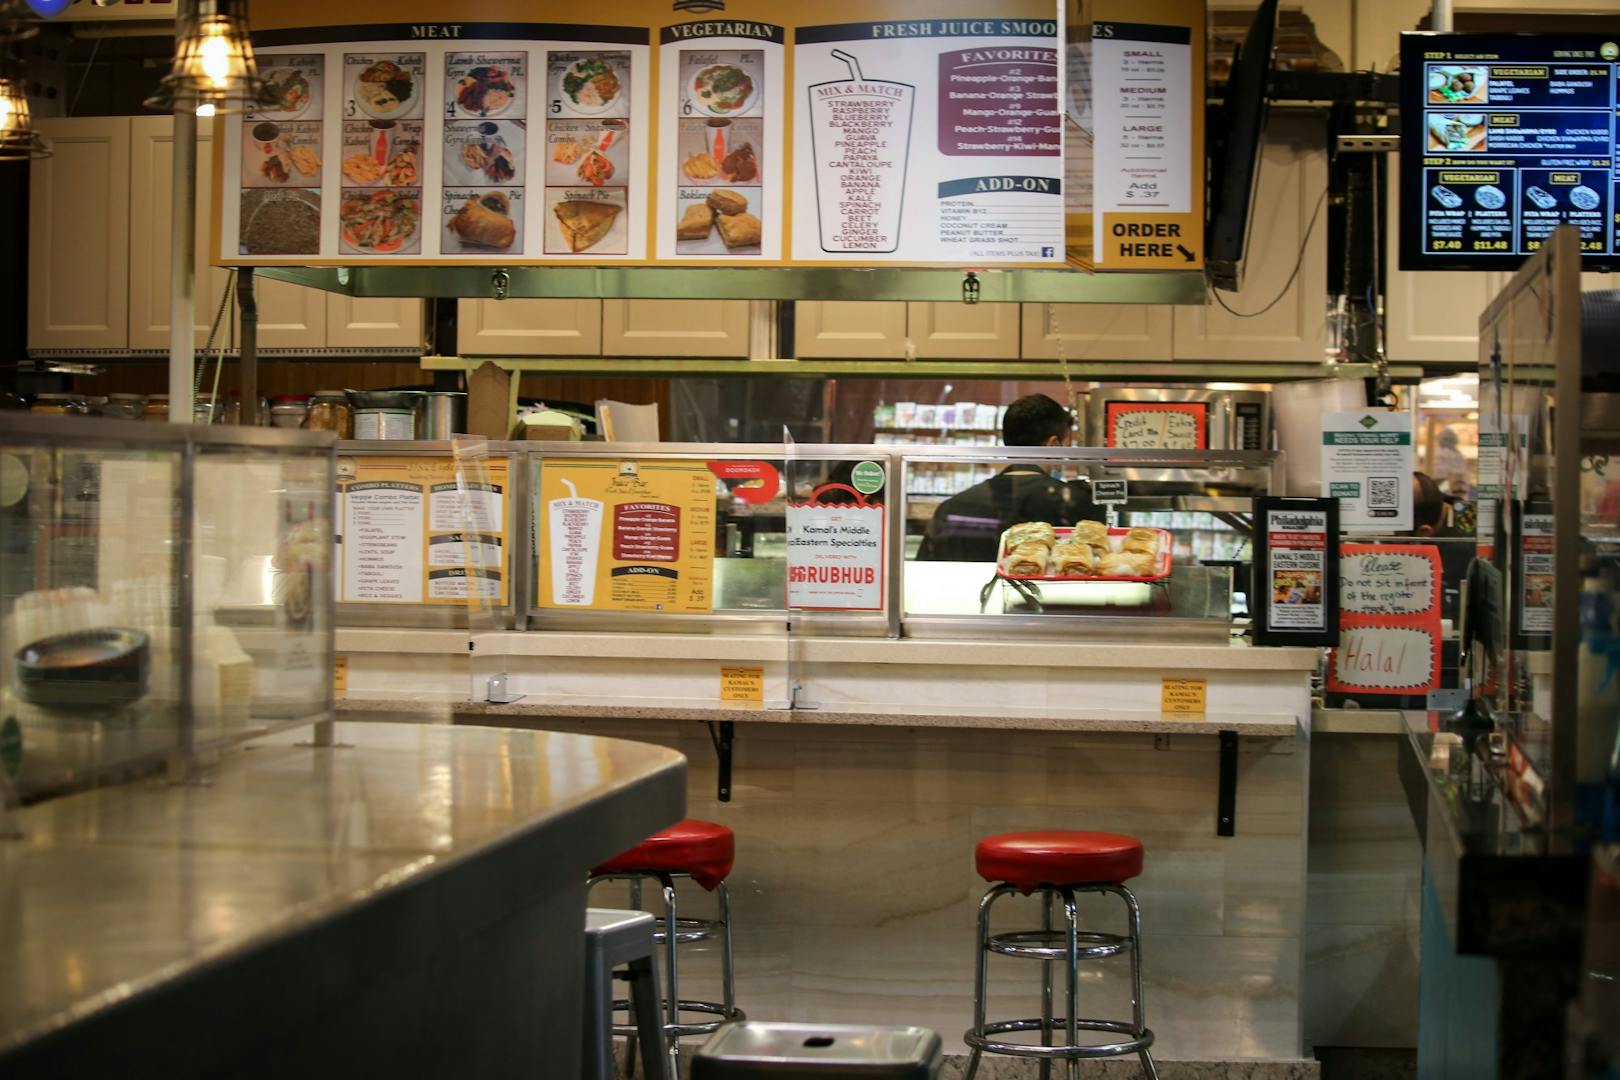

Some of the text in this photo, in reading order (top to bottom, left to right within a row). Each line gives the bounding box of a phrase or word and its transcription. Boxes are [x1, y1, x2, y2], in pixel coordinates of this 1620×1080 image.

[412, 25, 462, 38] MEAT
[671, 22, 774, 38] VEGETARIAN
[872, 22, 931, 38] FRESH
[939, 21, 993, 35] JUICE
[448, 55, 474, 65] Lamb
[951, 75, 1058, 83] Pineapple-Orange-Ban
[818, 85, 904, 98] MIX & MATCH
[447, 101, 456, 117] 4
[552, 100, 562, 114] 5
[683, 99, 692, 115] 6
[962, 109, 1060, 117] Mango-Orange-Gua
[955, 125, 1061, 134] Peach-Strawberry-Gu
[957, 142, 1061, 151] Strawberry-Kiwi-Man
[976, 178, 1050, 191] ADD-ON
[1112, 223, 1181, 237] ORDER
[1120, 243, 1173, 257] HERE
[624, 504, 671, 512] FAVORITES
[1271, 515, 1323, 527] Philadelphia
[803, 526, 870, 535] Kamal's Middle
[795, 538, 877, 548] Eastern Specialties
[1360, 555, 1403, 572] Please
[798, 566, 875, 585] GRUBHUB
[1357, 579, 1371, 587] not
[1376, 579, 1392, 587] sit
[1361, 590, 1376, 600] the
[1343, 636, 1407, 674] Halal
